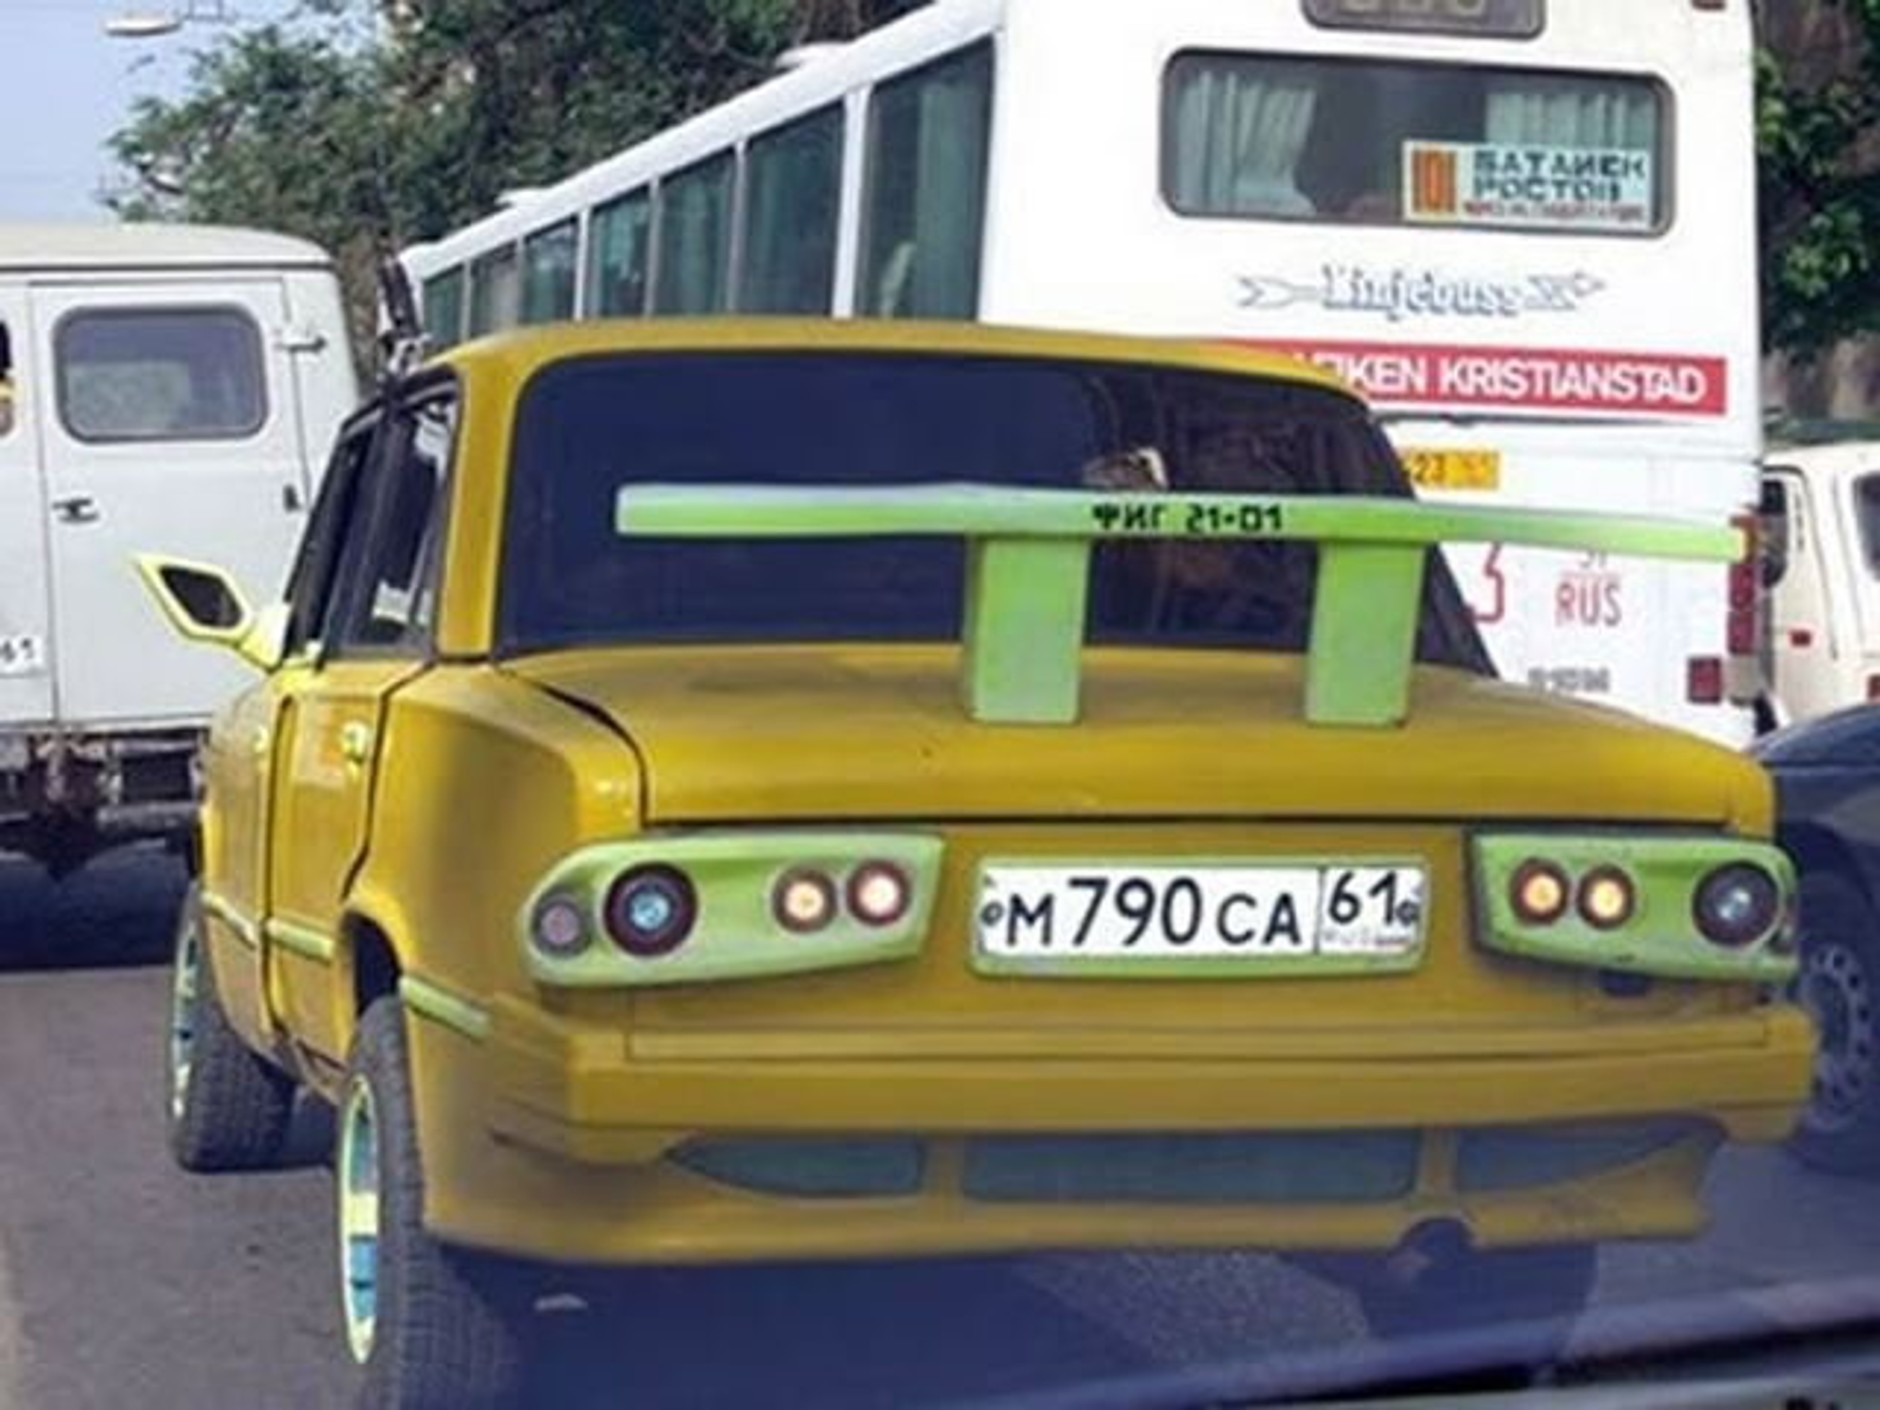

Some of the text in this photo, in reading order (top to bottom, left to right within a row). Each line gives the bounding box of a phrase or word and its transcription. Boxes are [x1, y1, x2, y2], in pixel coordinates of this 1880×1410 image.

[1439, 355, 1708, 402] KRISTIANSTAD
[1555, 580, 1622, 628] RUS
[1328, 870, 1397, 926] 61
